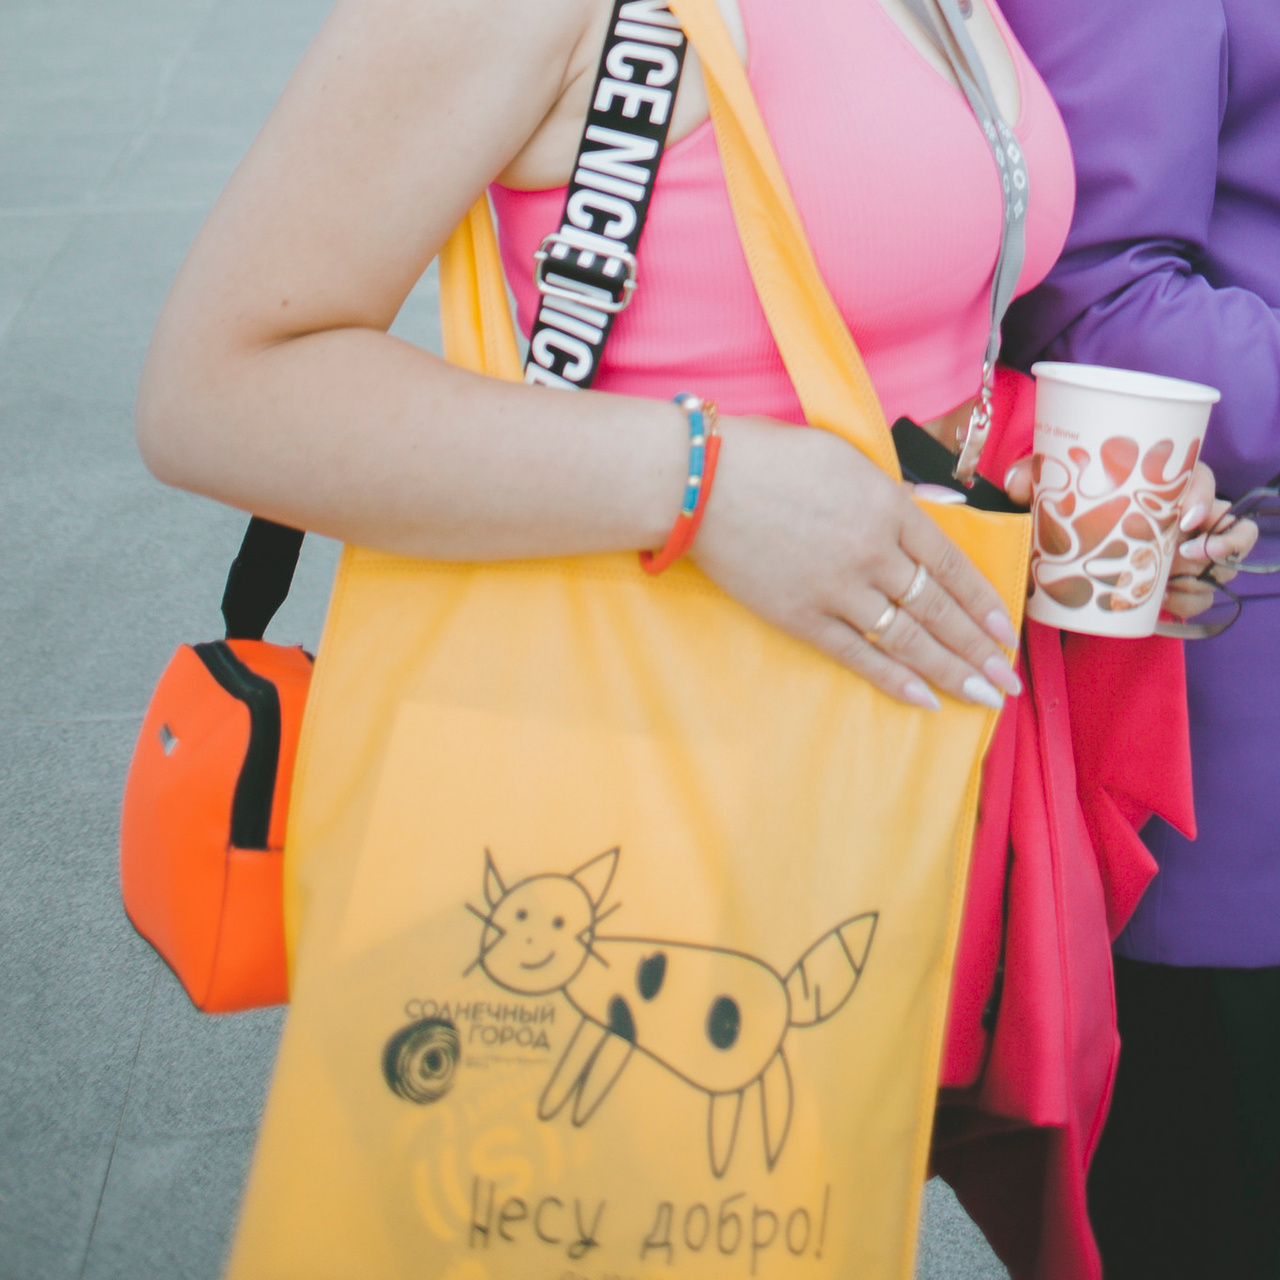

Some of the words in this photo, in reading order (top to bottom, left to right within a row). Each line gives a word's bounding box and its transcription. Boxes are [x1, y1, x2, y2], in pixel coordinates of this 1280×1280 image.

[551, 124, 660, 279] NICE
[404, 999, 556, 1024] СОЛНЕЧНЫЙ
[468, 1024, 551, 1051] ГОРОД
[467, 1174, 607, 1260] Несу
[640, 1182, 830, 1277] добро!
